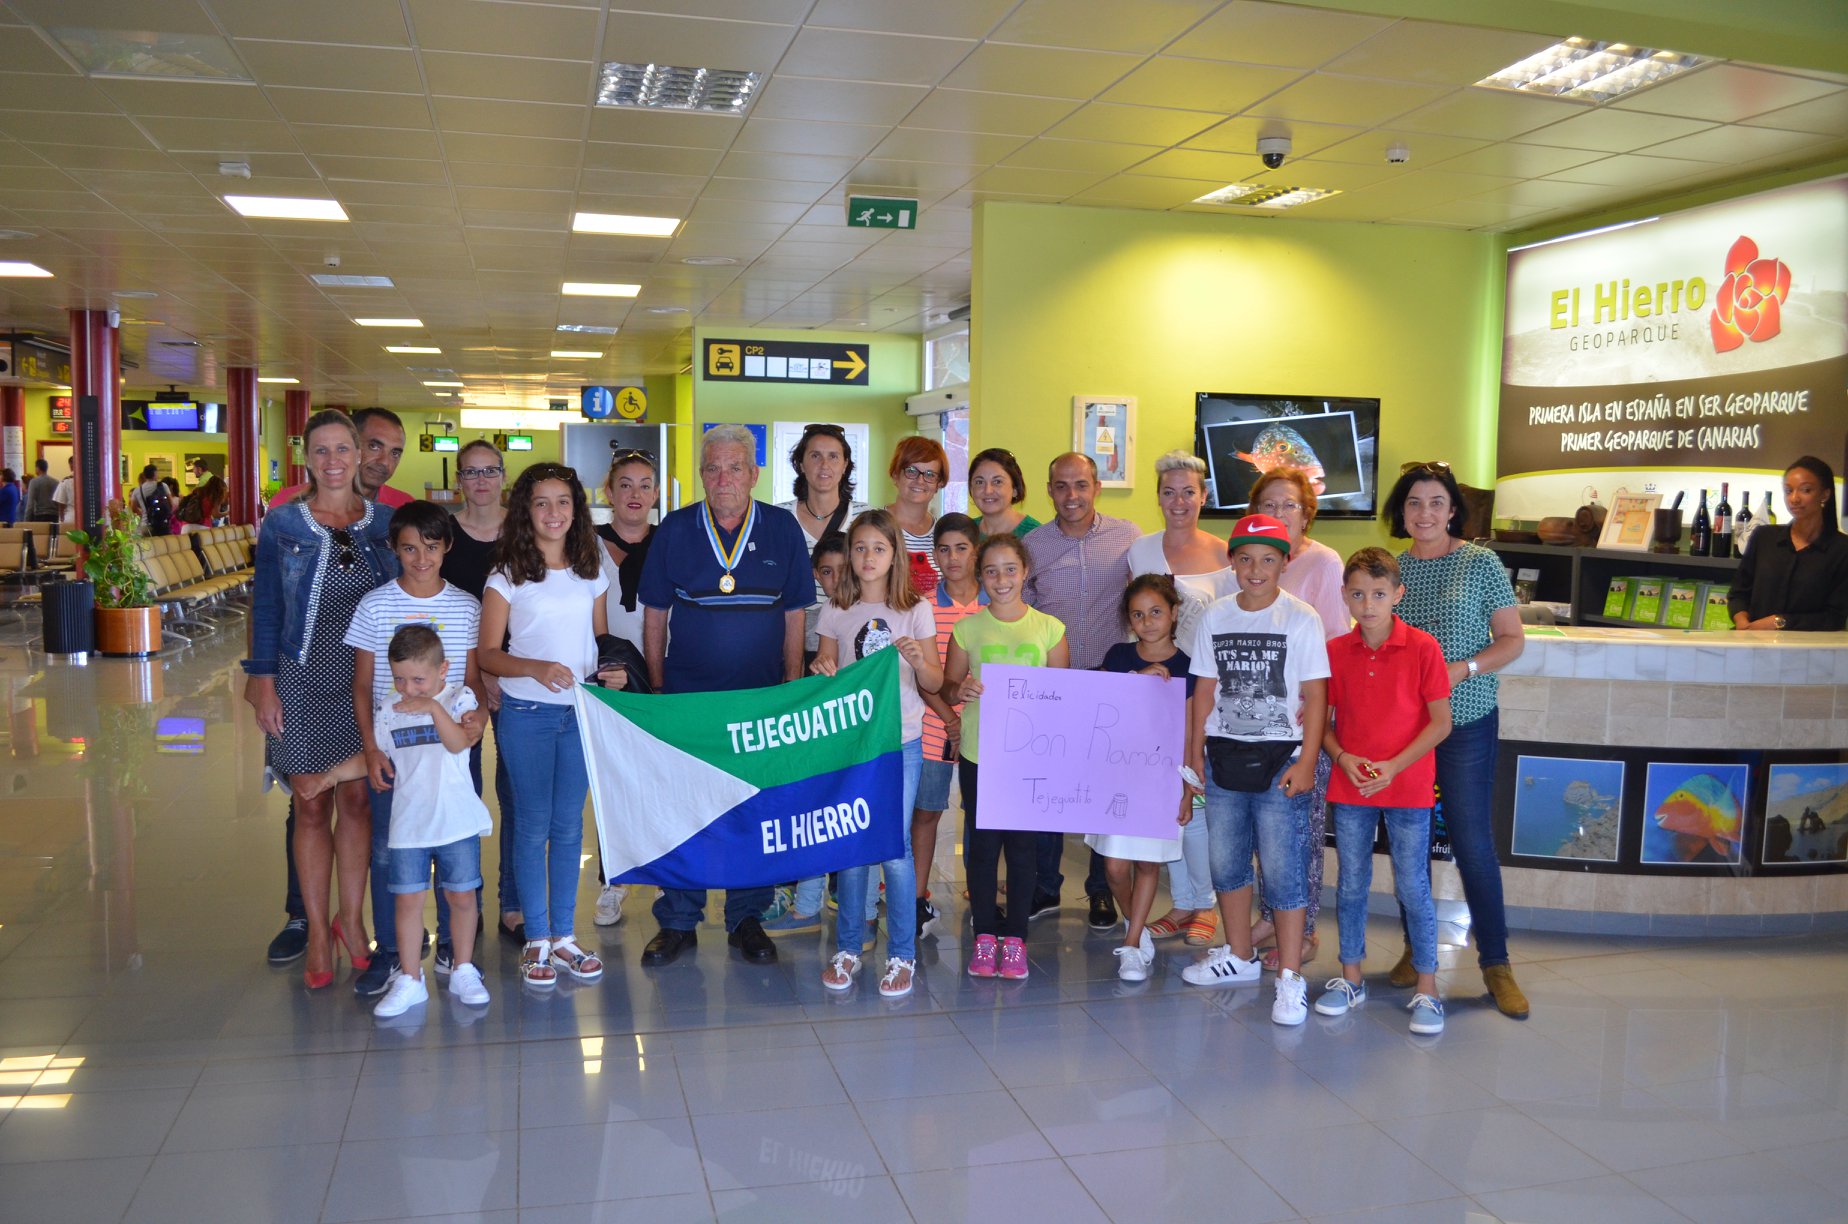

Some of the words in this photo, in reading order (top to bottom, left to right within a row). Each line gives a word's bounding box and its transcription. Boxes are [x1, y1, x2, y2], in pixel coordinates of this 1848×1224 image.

[1550, 287, 1580, 329] El
[1593, 276, 1706, 324] Hierro
[745, 345, 765, 355] CP2
[1570, 324, 1679, 351] GEOPARQUE
[1529, 405, 1575, 426] PRIMERA
[1578, 402, 1601, 423] ISLA
[1605, 401, 1622, 422] EN
[1626, 393, 1671, 421] ESPAÑA
[1675, 396, 1694, 419] EN
[1699, 395, 1722, 418] SER
[1725, 390, 1809, 416] GEOPARQUE
[421, 435, 433, 451] 3
[1561, 432, 1602, 452] PRIMER
[1604, 430, 1674, 451] GEOPARQUE
[1677, 430, 1694, 449] DE
[1697, 424, 1759, 451] CANARIAS
[1218, 650, 1237, 661] IT'S
[1262, 650, 1279, 661] ME
[1237, 639, 1261, 647] MARIO
[727, 689, 873, 754] TEJEGUATITO
[1004, 707, 1066, 758] Don
[1088, 703, 1173, 767] Ramón
[1022, 778, 1092, 814] Tejeguatito
[761, 818, 787, 854] EL
[791, 797, 871, 849] HIERRO
